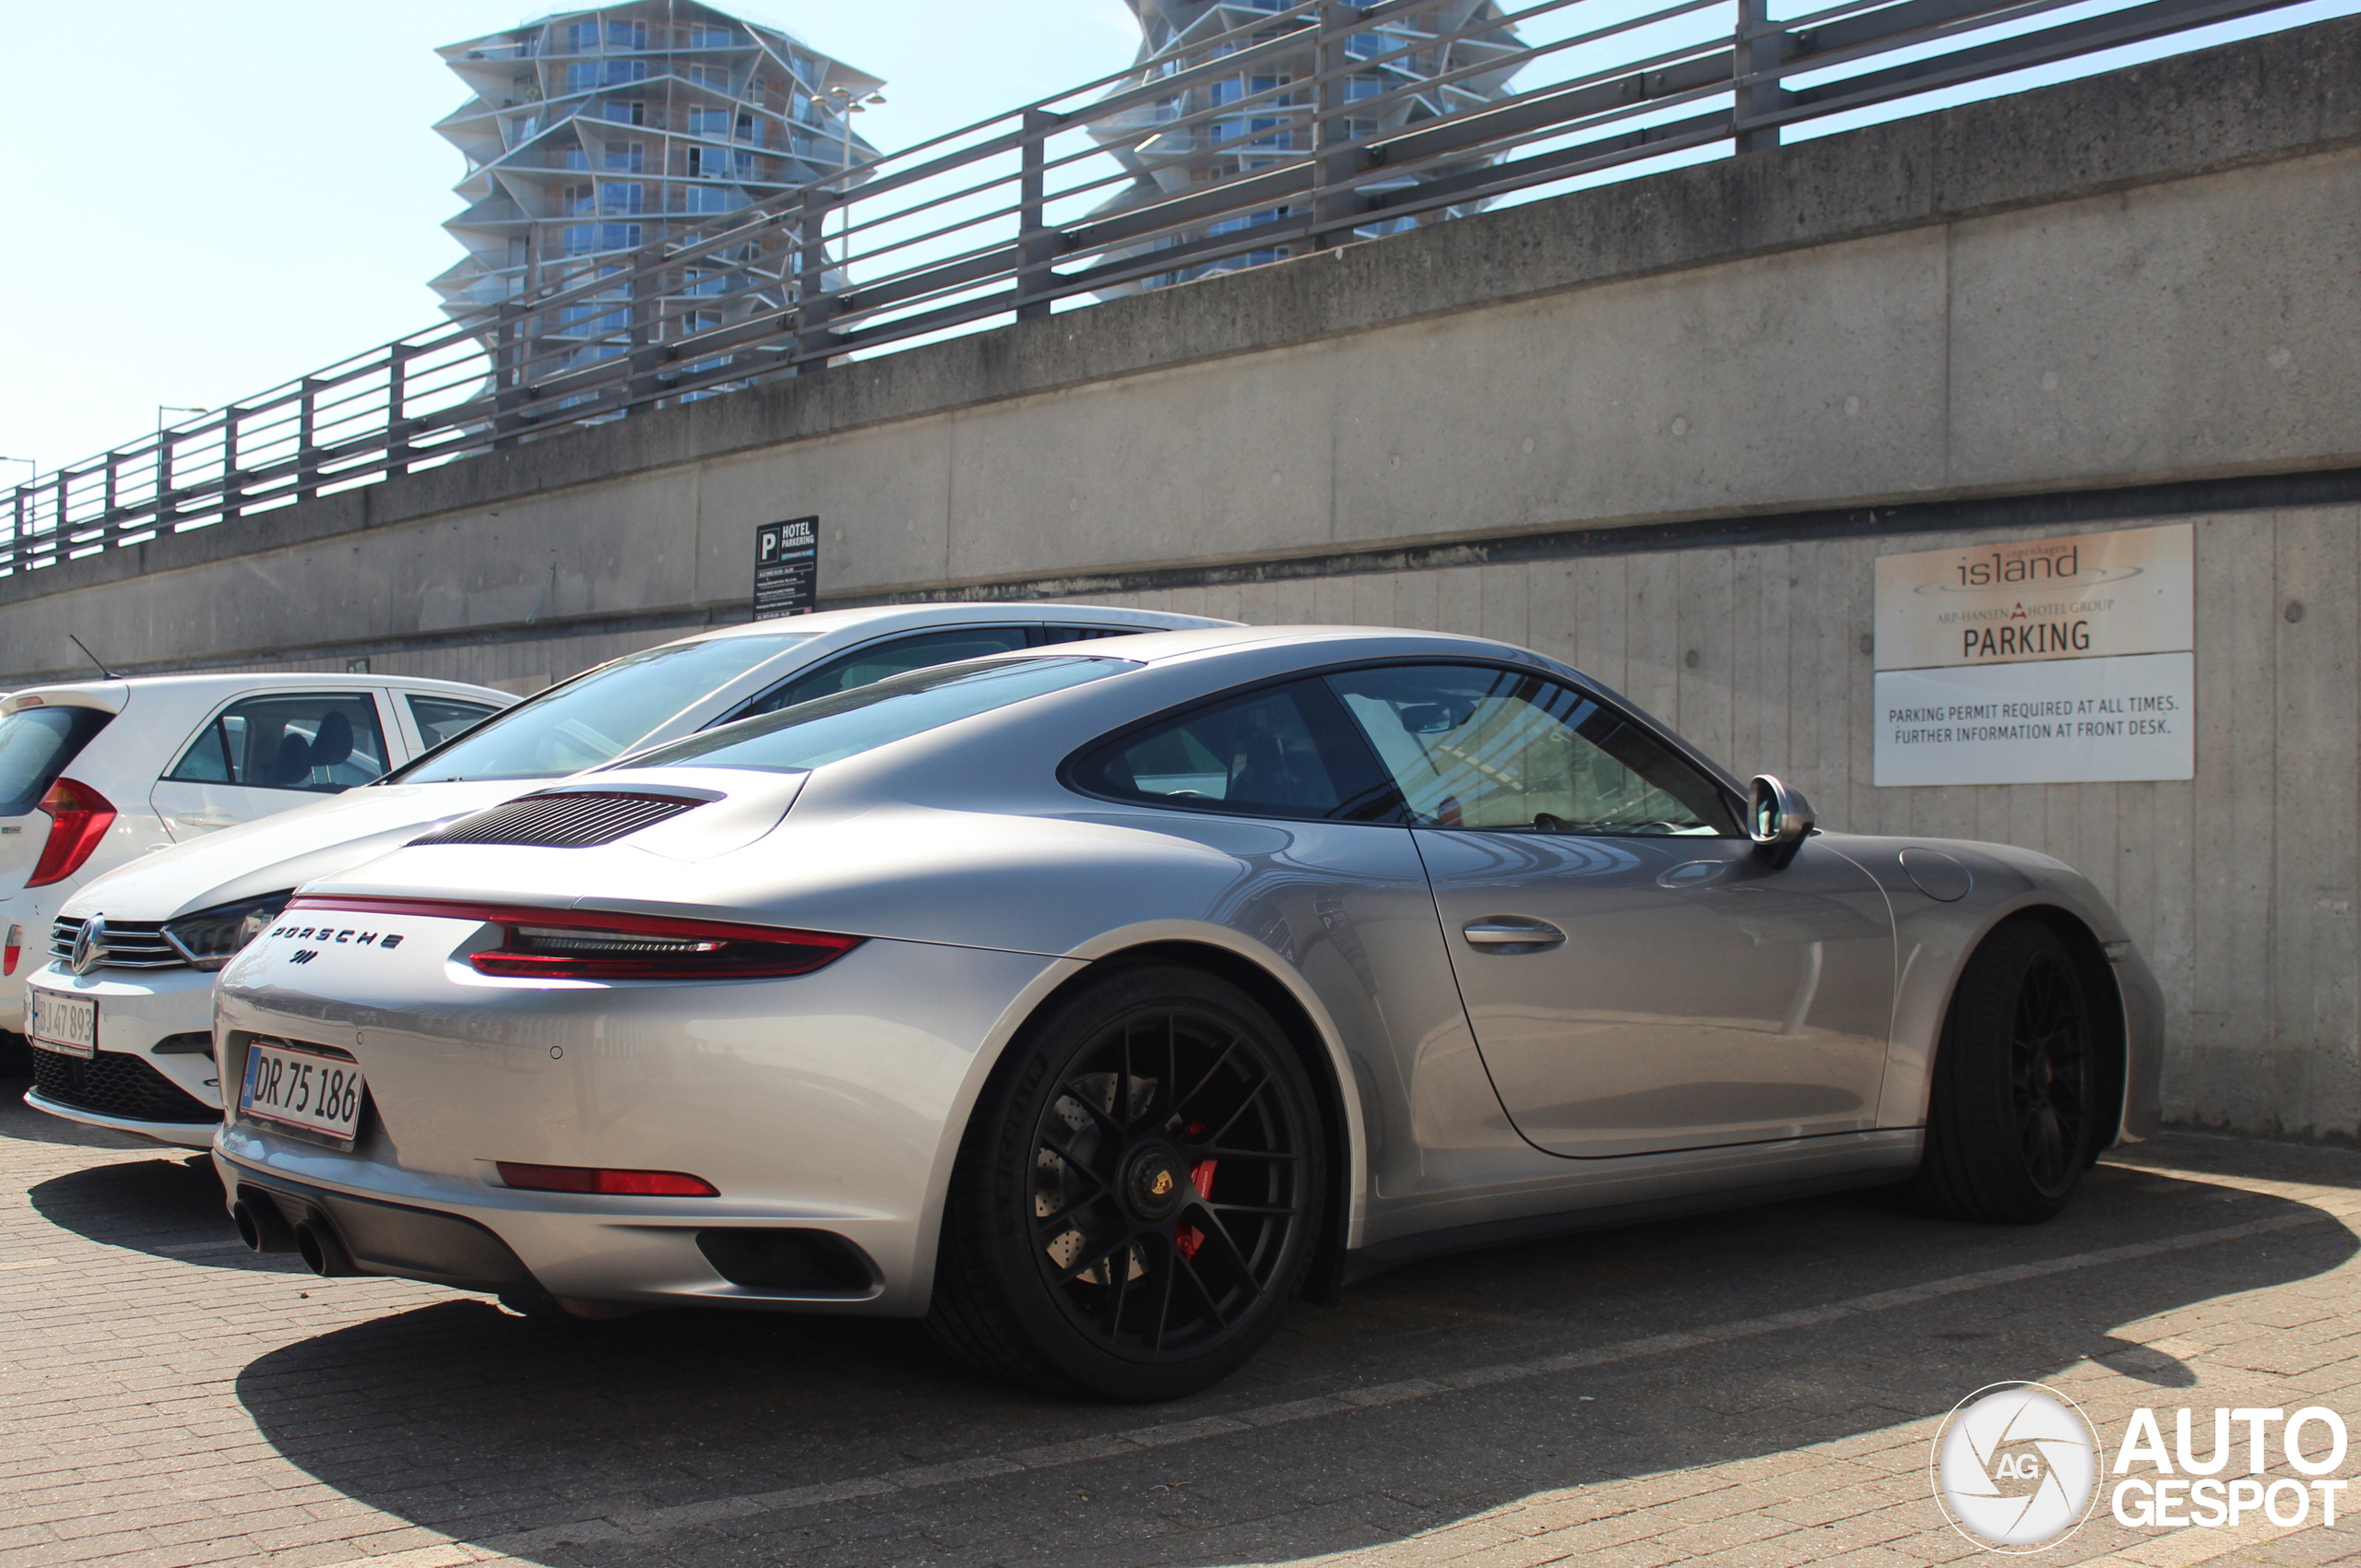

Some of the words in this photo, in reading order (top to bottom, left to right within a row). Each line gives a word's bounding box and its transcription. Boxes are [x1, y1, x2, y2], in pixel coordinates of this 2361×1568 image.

[782, 535, 814, 549] PARKERING
[783, 522, 811, 540] HOTEL
[762, 533, 777, 560] P
[1957, 545, 2078, 587] island
[1937, 608, 2010, 624] ARP-HANSEN
[2028, 604, 2069, 617] HOTEL
[2070, 600, 2115, 613] GROUP
[1964, 621, 2091, 658] PARKING
[1889, 707, 1944, 723] PARKING
[1949, 704, 1998, 720] PERMIT
[2002, 701, 2072, 719] REQUIRED
[2077, 699, 2094, 715] AT
[2098, 698, 2124, 714] ALL
[2129, 695, 2178, 712] TIMES.
[1894, 728, 1952, 744] FURTHER
[1956, 724, 2051, 742] INFORMATION
[2056, 723, 2072, 738] AT
[2077, 721, 2124, 737] FRONT
[2129, 719, 2171, 736] DESK.
[271, 927, 405, 949] PORSCHE
[289, 949, 319, 965] 911
[54, 1004, 67, 1037] 47
[70, 1005, 92, 1042] 893
[254, 1056, 283, 1106] DR
[284, 1062, 314, 1112] 75
[315, 1068, 357, 1123] 186
[996, 1055, 1047, 1197] MICHELIN
